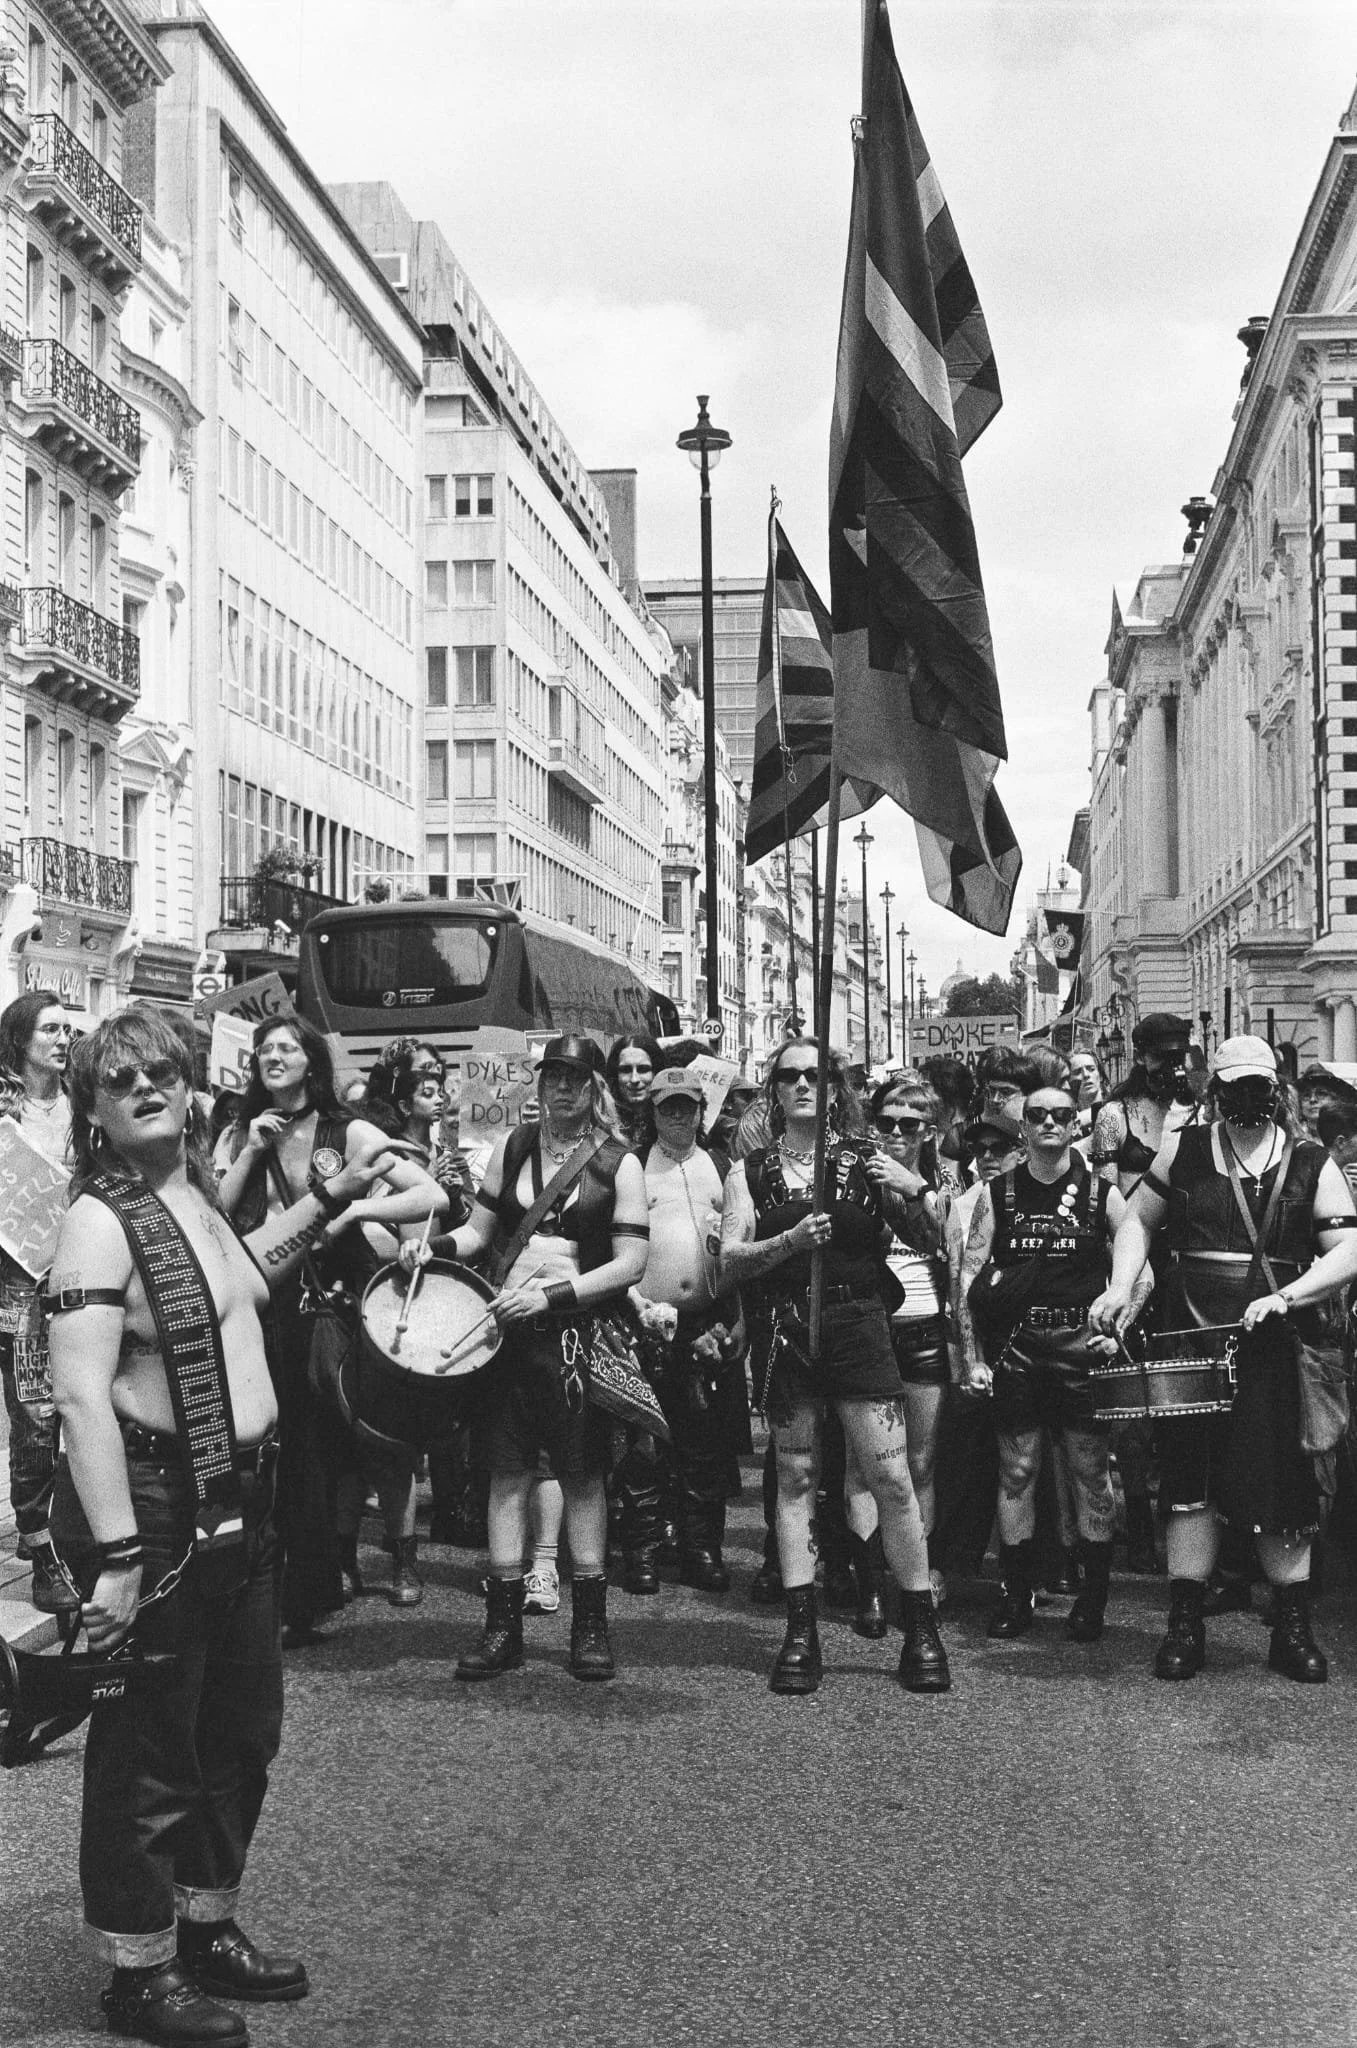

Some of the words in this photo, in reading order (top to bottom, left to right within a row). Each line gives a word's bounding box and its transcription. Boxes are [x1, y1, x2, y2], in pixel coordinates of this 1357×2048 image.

[704, 1024, 721, 1035] 20
[466, 1060, 534, 1086] DYKES
[495, 1087, 512, 1103] 4
[20, 1202, 67, 1251] TIM
[92, 1685, 125, 1700] PYLE
